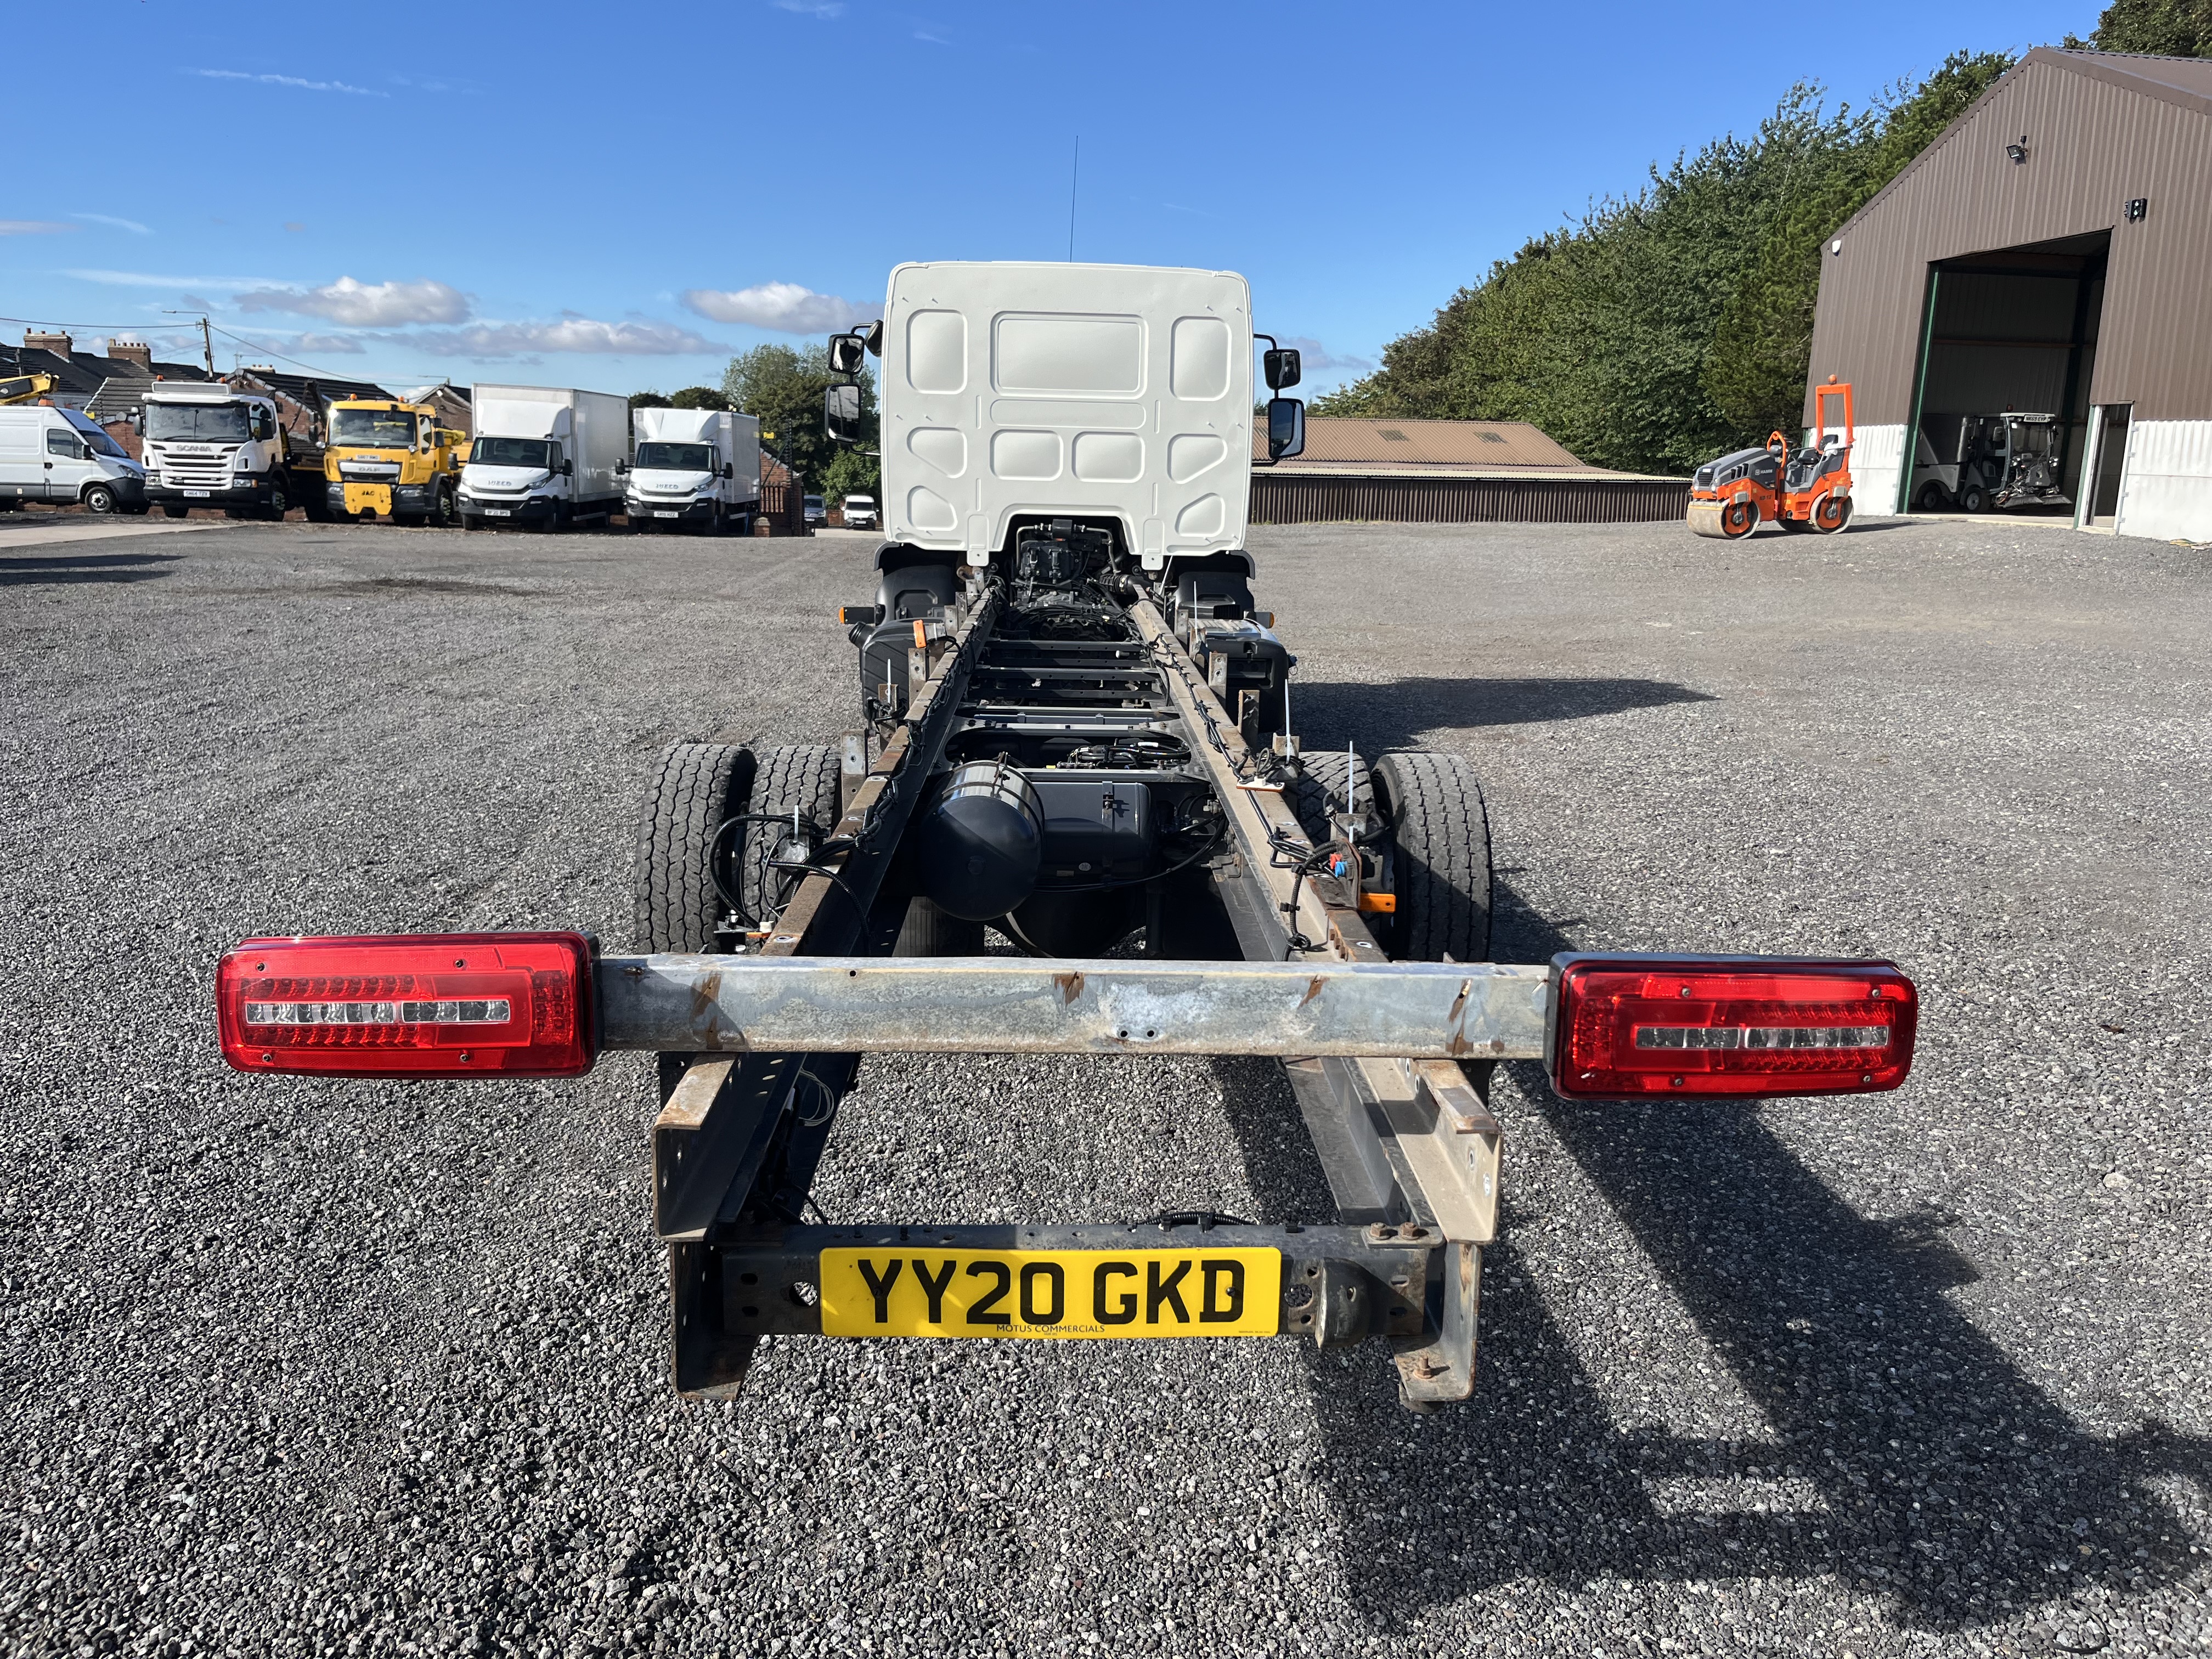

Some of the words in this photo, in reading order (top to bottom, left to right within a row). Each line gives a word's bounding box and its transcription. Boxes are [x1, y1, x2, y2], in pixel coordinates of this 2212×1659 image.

[857, 1259, 1064, 1325] YY20
[1092, 1259, 1245, 1324] GKD
[1035, 1324, 1105, 1333] COMMERCIALS
